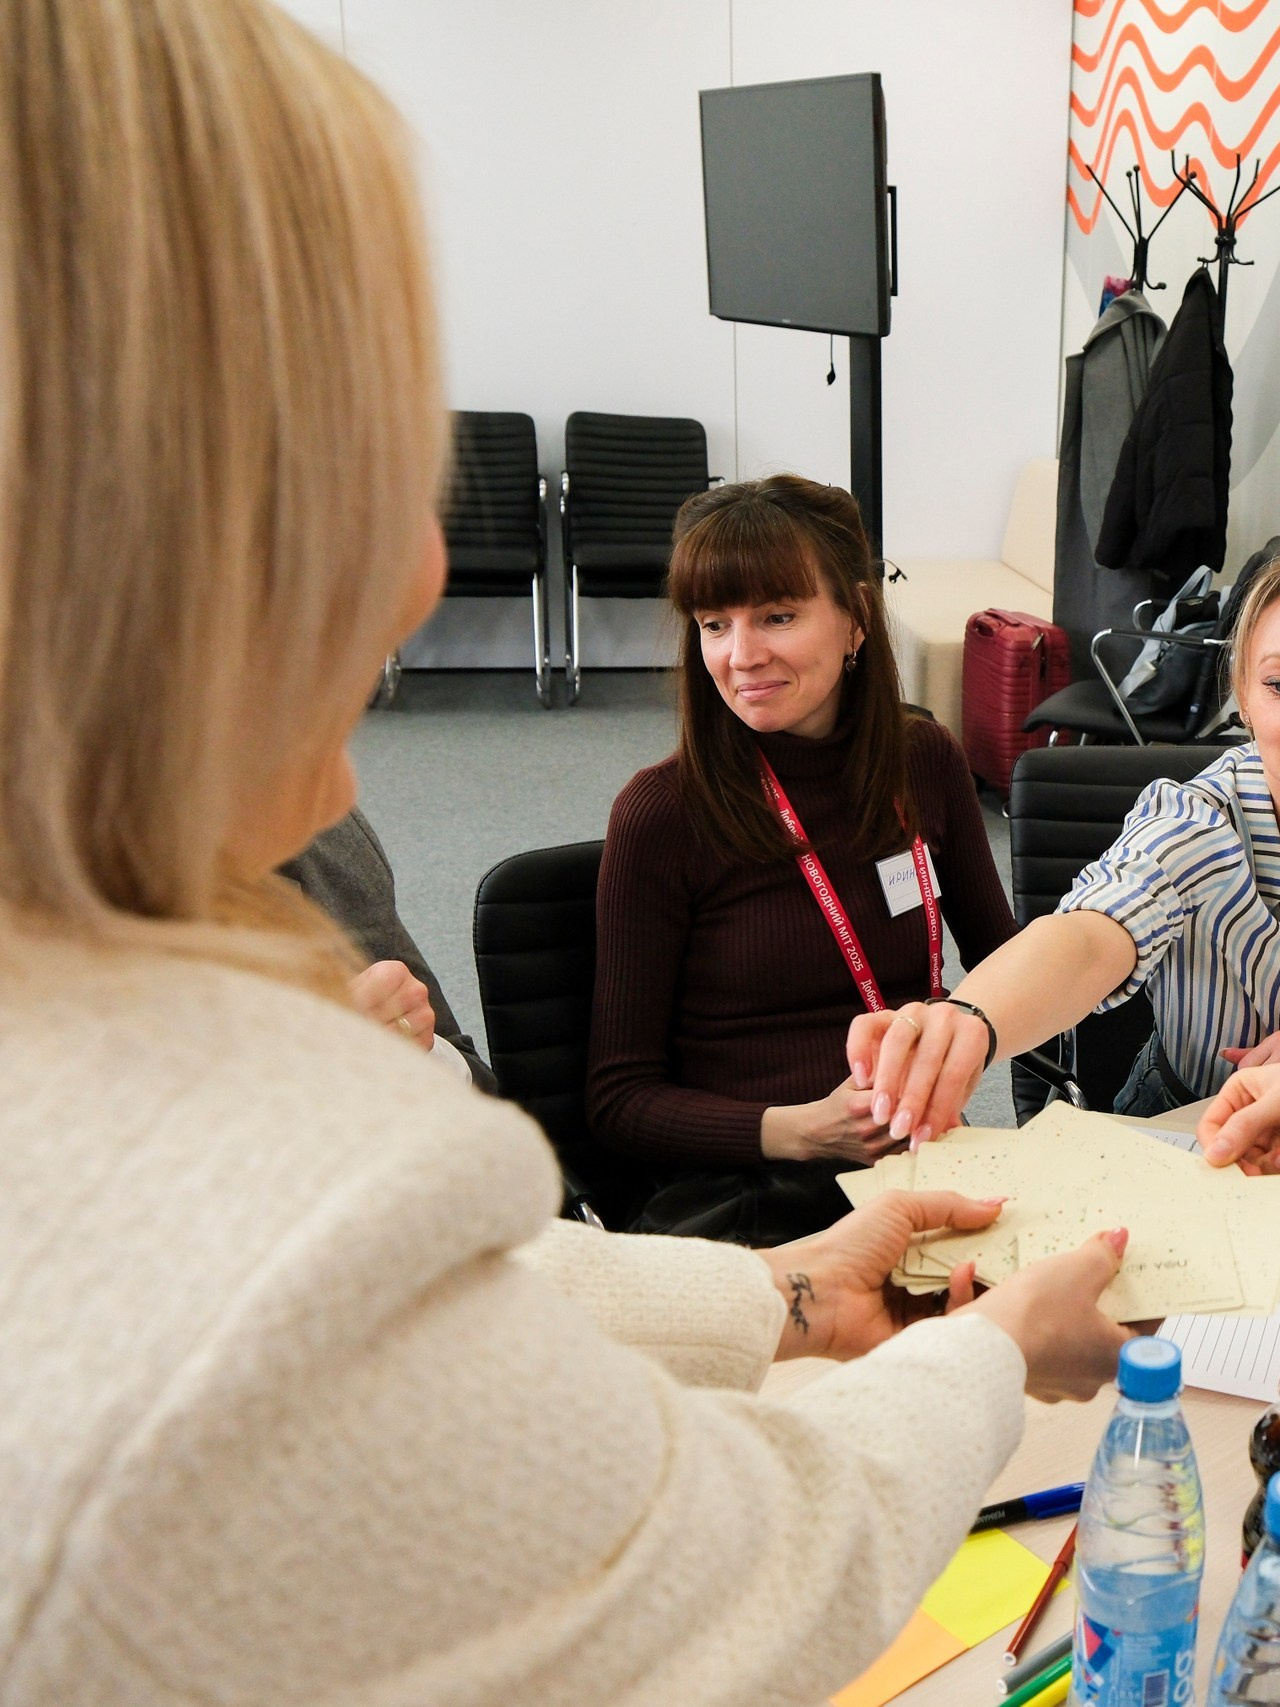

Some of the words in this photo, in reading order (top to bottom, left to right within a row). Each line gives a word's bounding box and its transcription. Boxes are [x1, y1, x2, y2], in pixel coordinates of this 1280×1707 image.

[888, 867, 916, 887] ИРИН
[918, 866, 938, 941] НОВОГОДНИЙ
[801, 854, 844, 926] НОВОГОДНИЙ
[846, 946, 865, 972] 2025
[932, 952, 940, 989] Добрый
